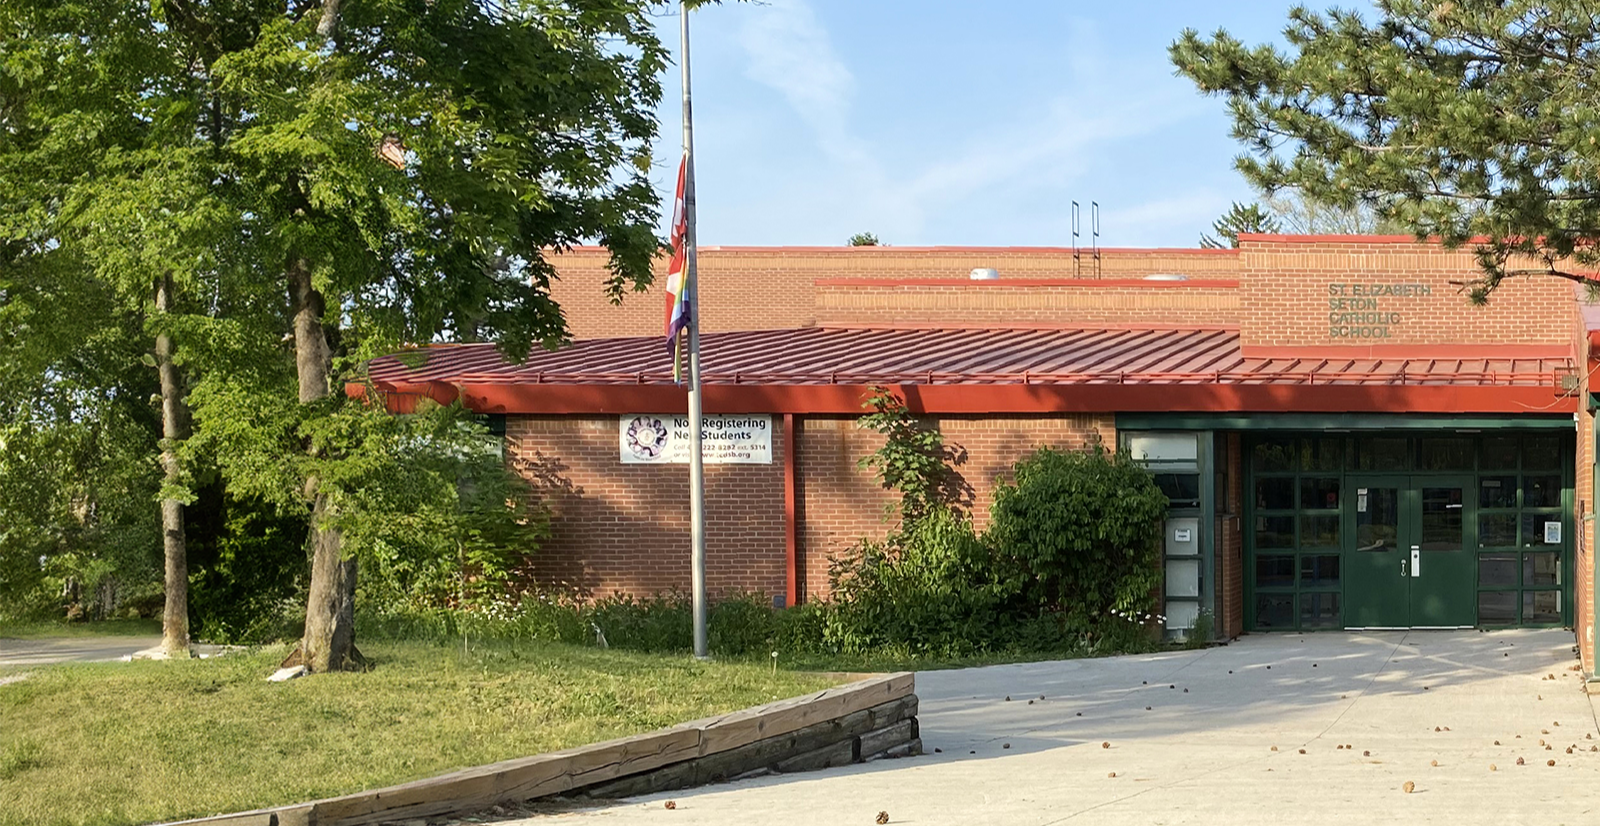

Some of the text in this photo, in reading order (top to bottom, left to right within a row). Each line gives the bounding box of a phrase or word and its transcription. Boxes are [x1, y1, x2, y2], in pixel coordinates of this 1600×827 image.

[1329, 283, 1431, 296] ST. ELIZABETH
[1329, 298, 1377, 310] SETON
[1329, 312, 1400, 325] CATHOLIC
[1329, 326, 1392, 338] SCHOOL
[674, 418, 766, 429] No Registering
[674, 431, 752, 440] Ne Students
